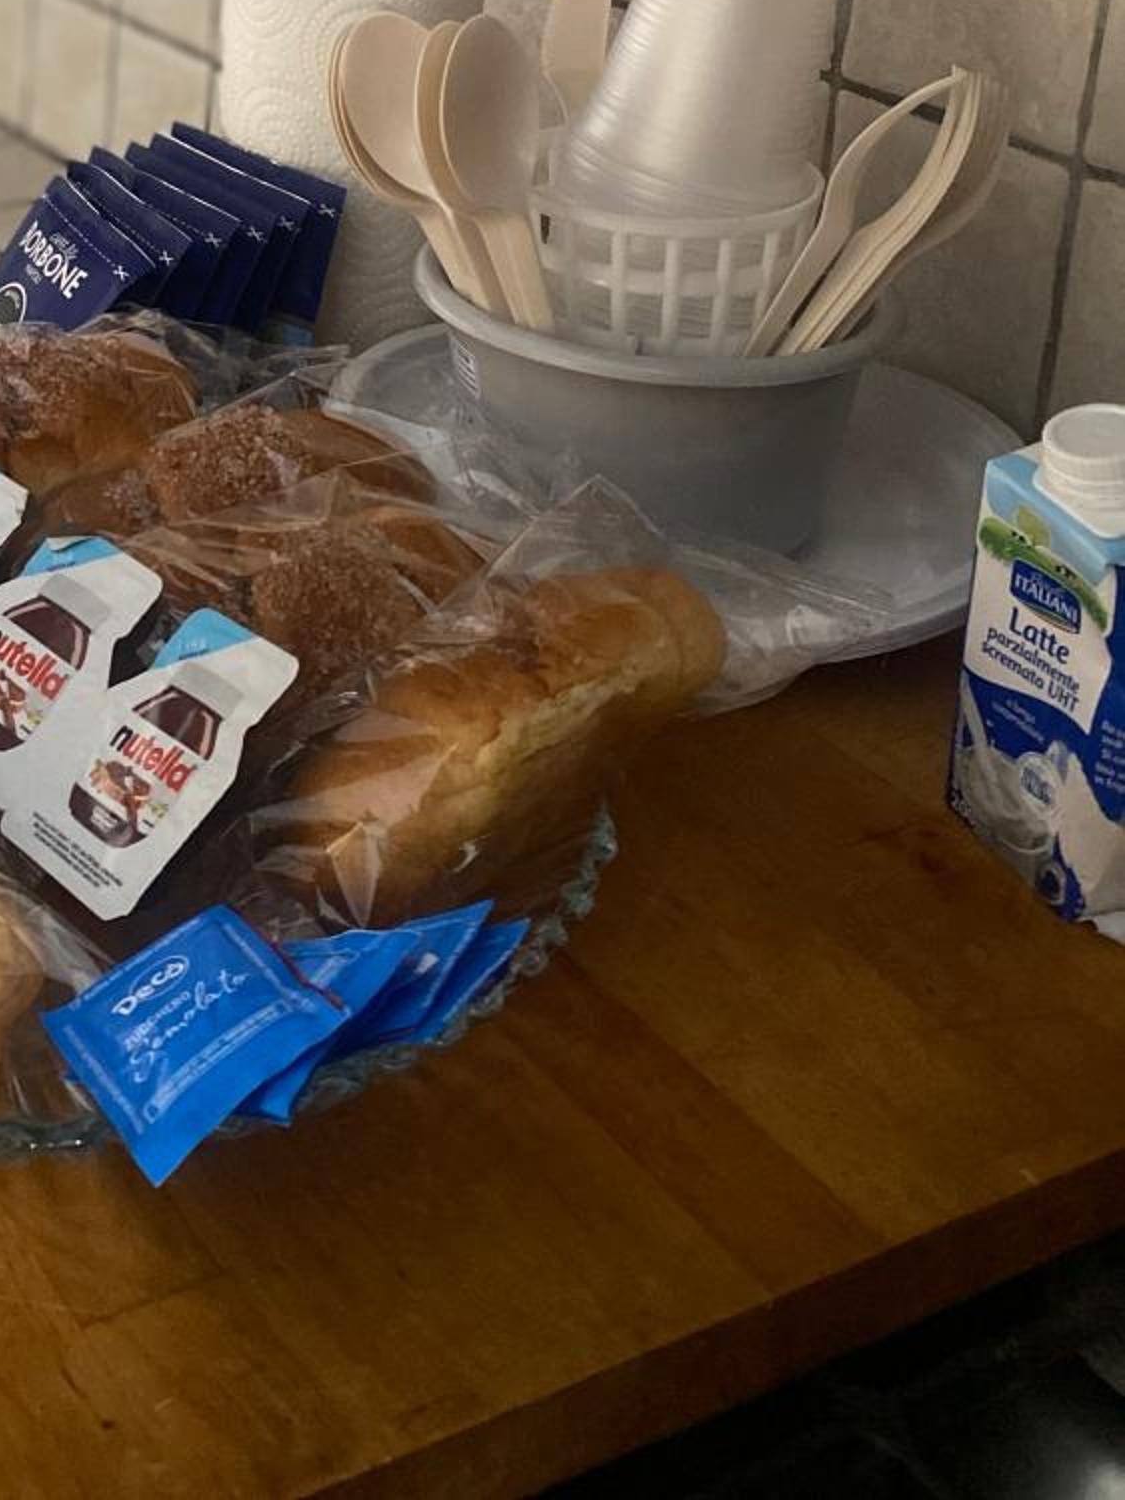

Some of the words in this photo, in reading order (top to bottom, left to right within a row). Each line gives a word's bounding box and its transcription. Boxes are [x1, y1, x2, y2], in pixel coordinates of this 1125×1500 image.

[1014, 573, 1079, 627] ITALIANI
[986, 627, 1080, 694] parzialmente
[1009, 606, 1070, 664] Latte
[981, 641, 1044, 689] scremato
[1047, 680, 1079, 712] UHT
[109, 725, 198, 793] nutella
